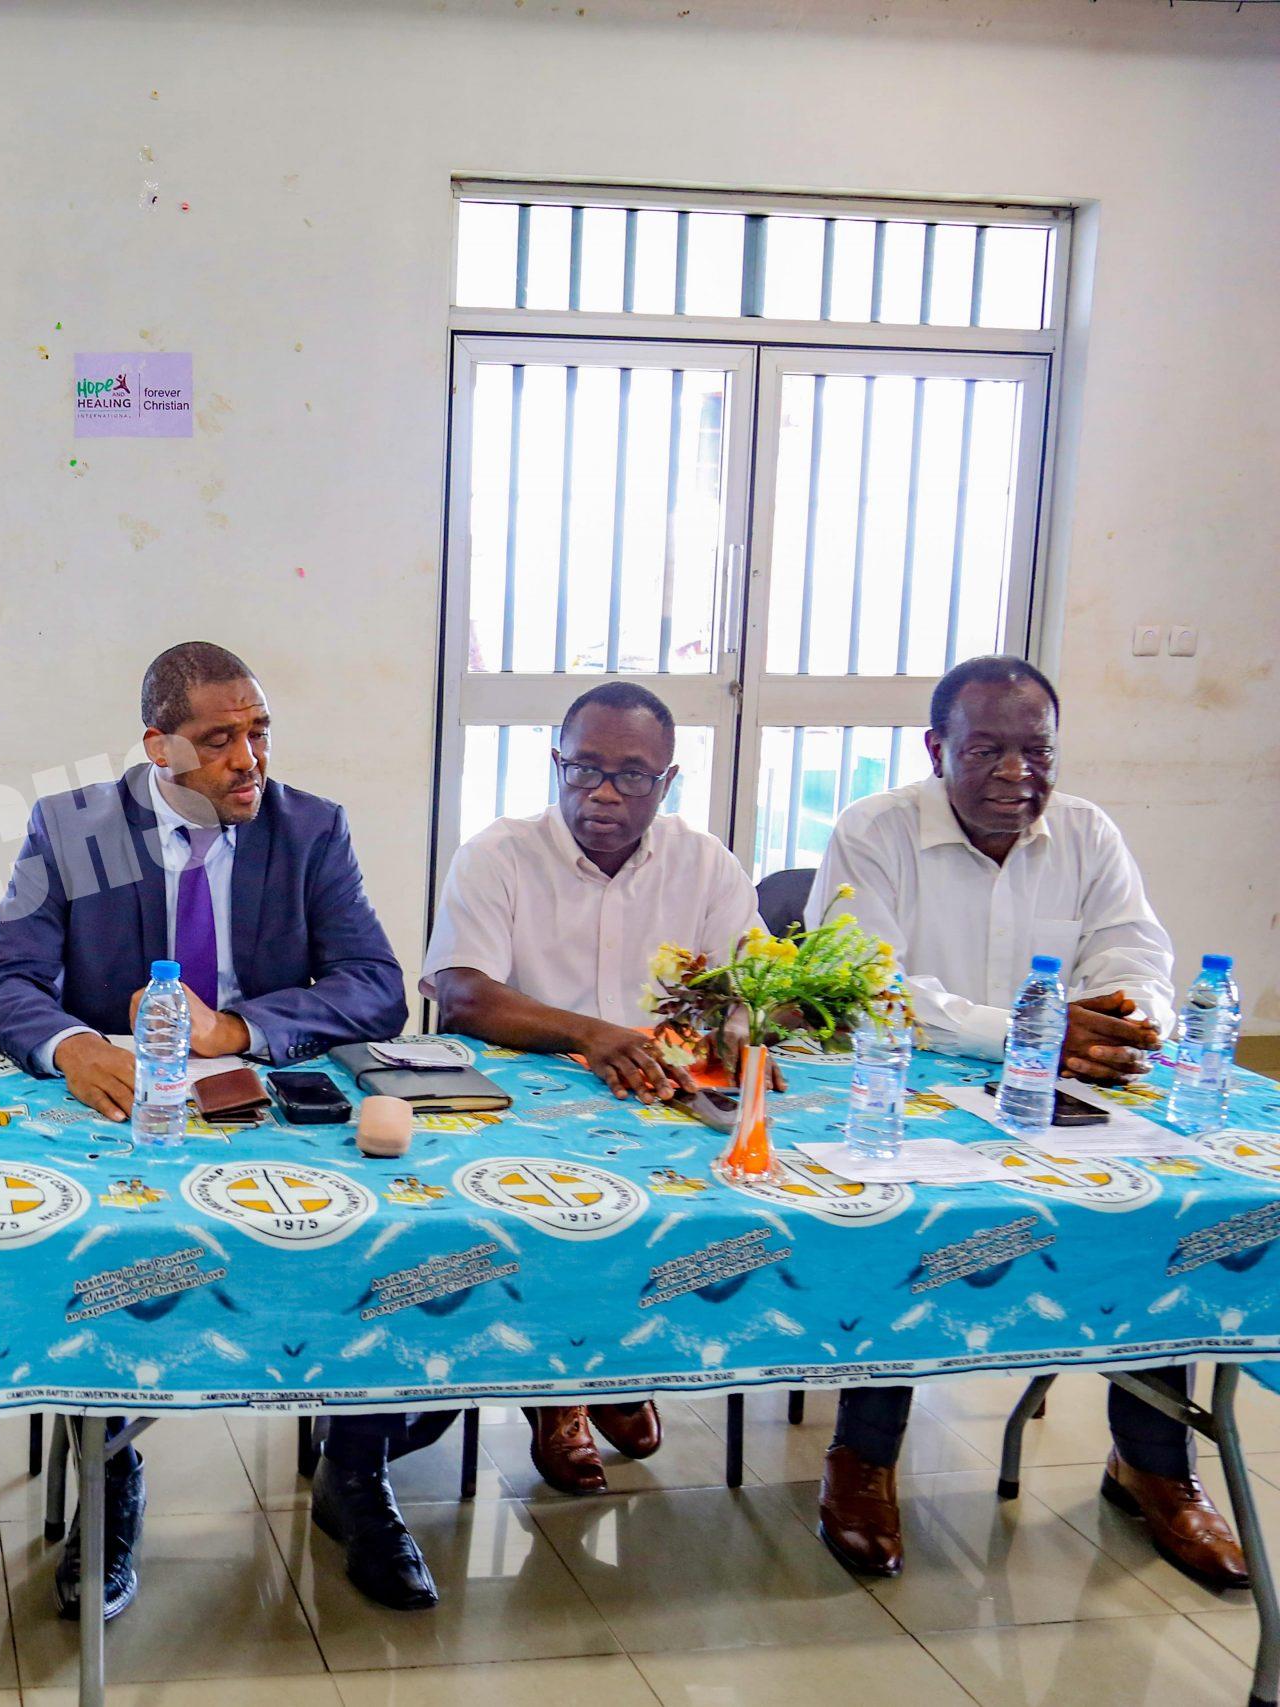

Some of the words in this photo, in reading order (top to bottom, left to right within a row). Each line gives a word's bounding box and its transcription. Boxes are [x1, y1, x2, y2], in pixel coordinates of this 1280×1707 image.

[77, 378, 113, 398] Hope
[144, 388, 181, 397] forever
[77, 399, 131, 408] HEALING
[143, 400, 190, 410] Christian
[829, 1202, 873, 1210] 1975
[559, 1212, 603, 1222] 1975
[273, 1219, 318, 1231] 1975
[75, 1271, 122, 1292] Assisting
[154, 1248, 204, 1268] Provision
[81, 1296, 138, 1317] expression
[152, 1278, 199, 1296] Christian
[200, 1269, 226, 1283] Love
[96, 1283, 129, 1299] Health
[131, 1277, 156, 1289] Care
